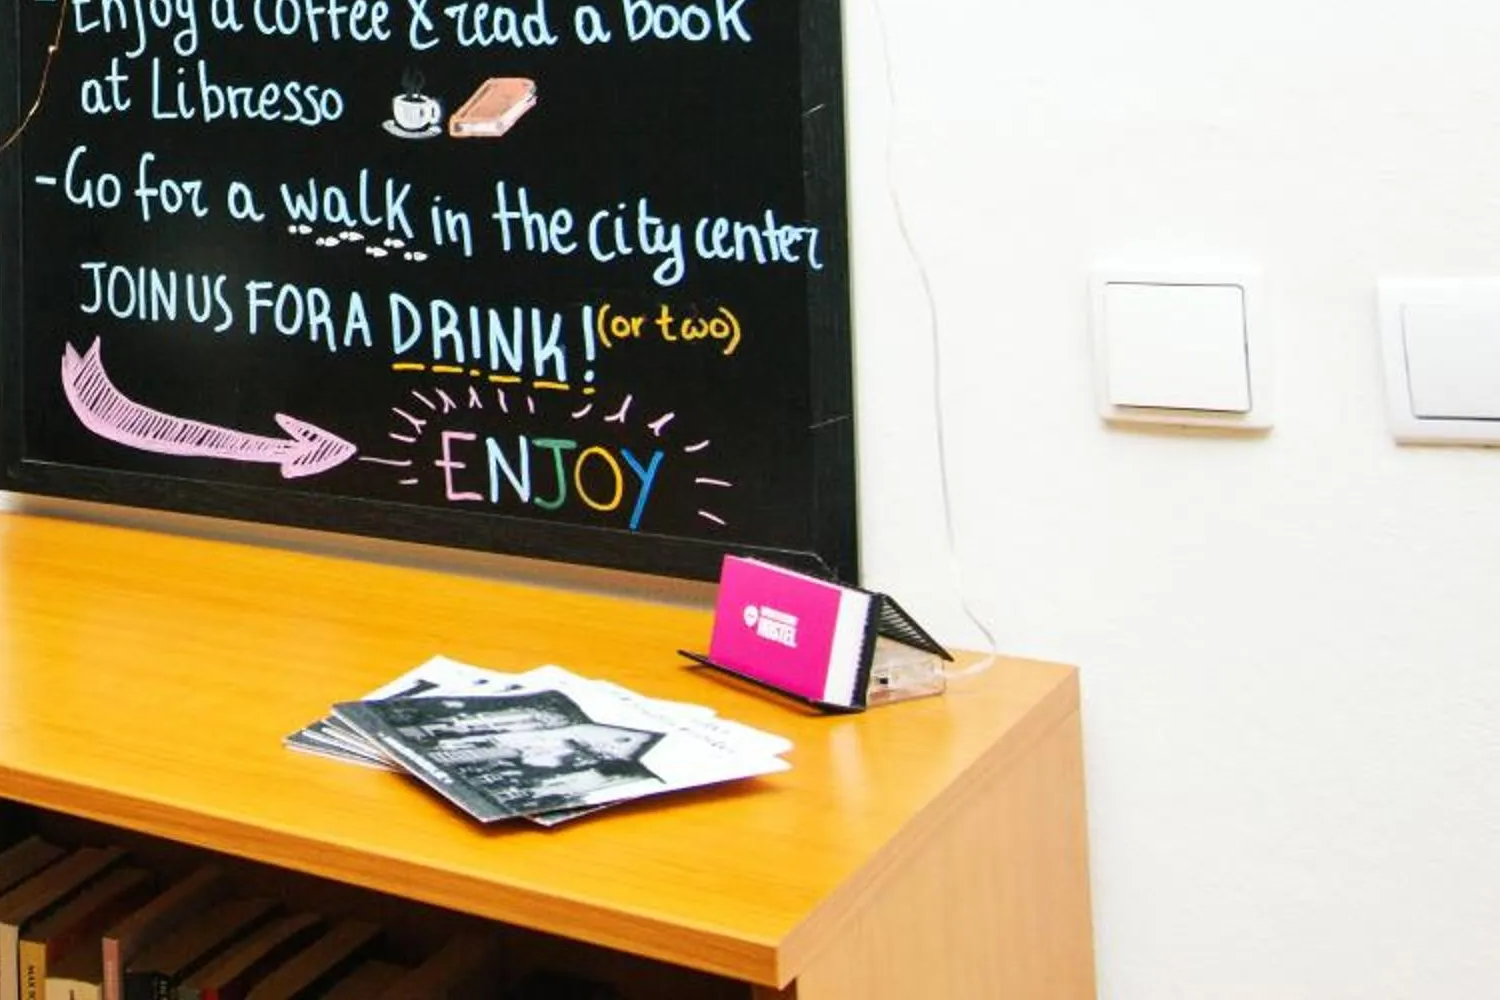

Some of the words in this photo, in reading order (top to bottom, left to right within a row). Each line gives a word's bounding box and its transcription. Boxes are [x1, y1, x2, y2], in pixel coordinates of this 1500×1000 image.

[574, 5, 612, 45] a
[81, 57, 132, 115] at
[152, 56, 345, 126] Libresso
[134, 152, 209, 223] for
[227, 181, 266, 222] a
[280, 168, 415, 240] walk
[431, 195, 473, 257] in
[492, 180, 578, 255] the
[588, 197, 686, 287] city
[695, 208, 824, 270] center
[80, 261, 177, 323] JOIN
[186, 273, 234, 333] US
[245, 281, 337, 353] FOR
[343, 291, 373, 349] A
[434, 431, 665, 532] ENJOY
